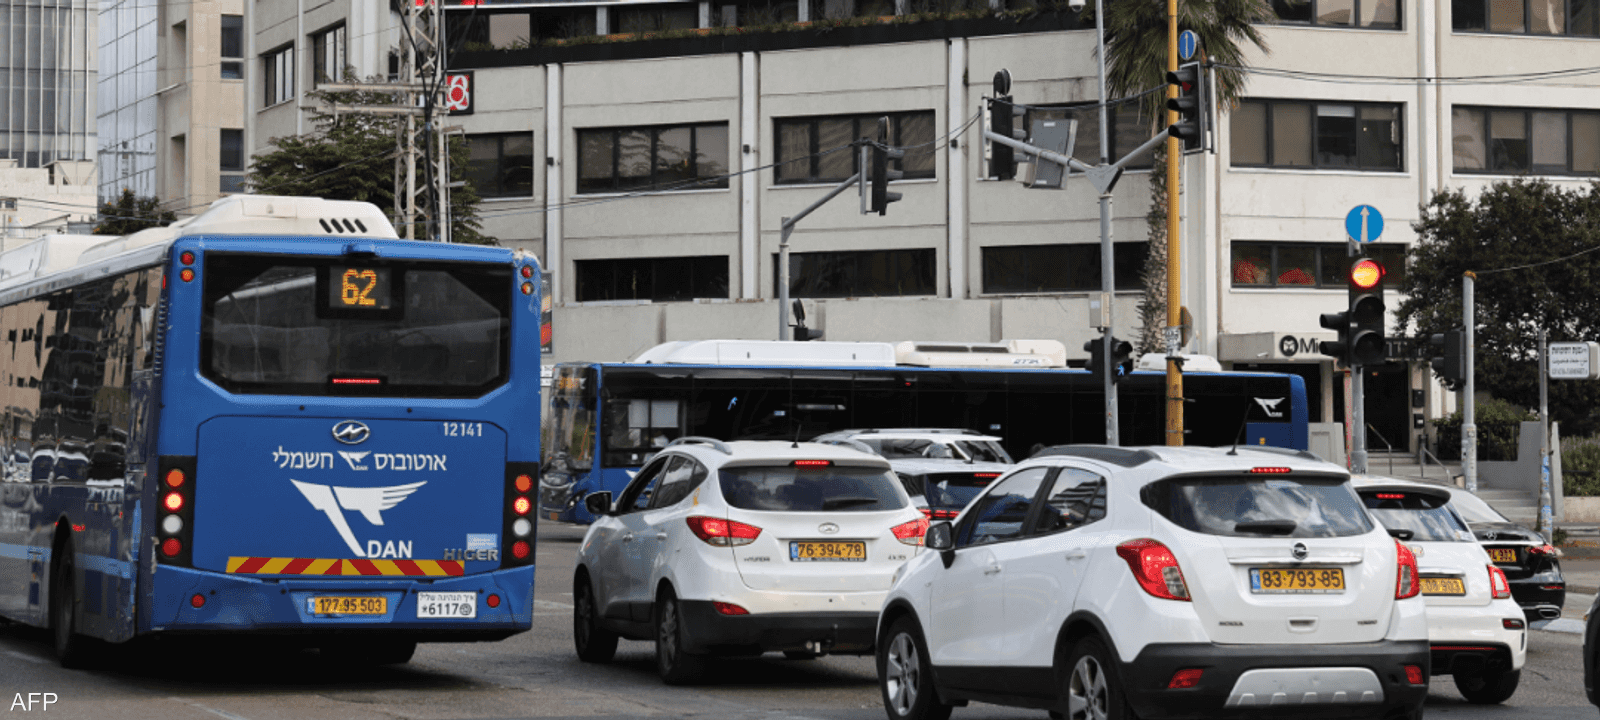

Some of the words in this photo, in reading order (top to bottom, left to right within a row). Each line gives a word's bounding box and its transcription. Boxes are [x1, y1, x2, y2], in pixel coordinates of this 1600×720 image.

[342, 268, 377, 306] 62
[443, 422, 483, 437] 12141
[272, 445, 334, 470] חשמלי
[373, 453, 447, 471] אוטובוס
[367, 540, 413, 558] DAN
[443, 548, 499, 561] HIGER
